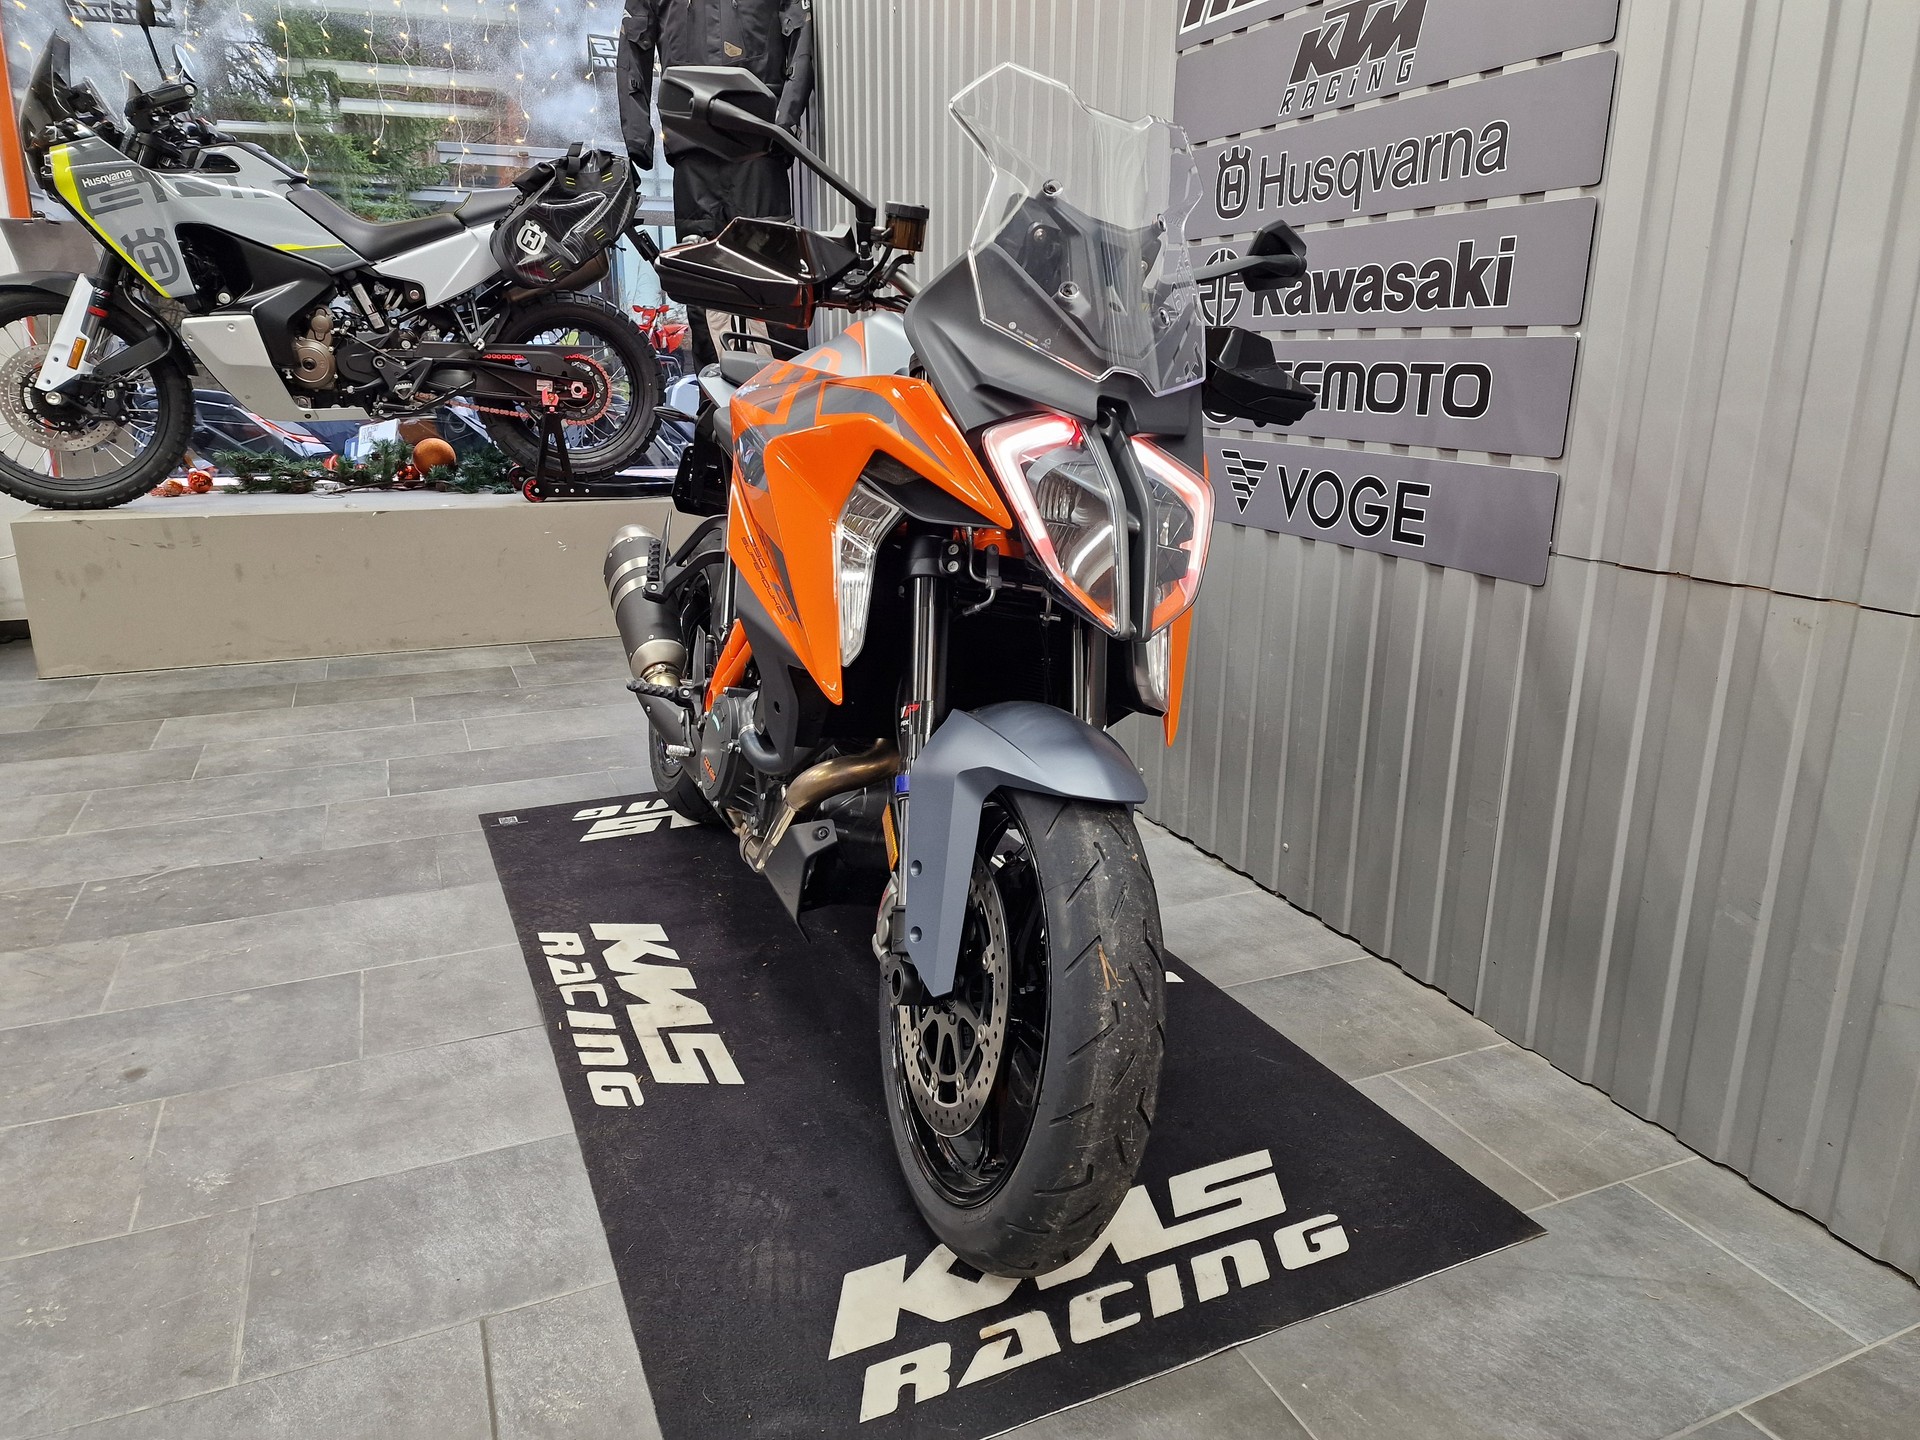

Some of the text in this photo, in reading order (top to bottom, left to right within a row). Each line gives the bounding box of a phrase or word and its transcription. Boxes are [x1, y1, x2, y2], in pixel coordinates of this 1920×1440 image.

[1287, 0, 1428, 86] KTM
[82, 169, 133, 188] Husqvarna
[1258, 119, 1509, 211] Husqvarna
[1277, 465, 1431, 547] VOGE
[589, 923, 744, 1084] KMS
